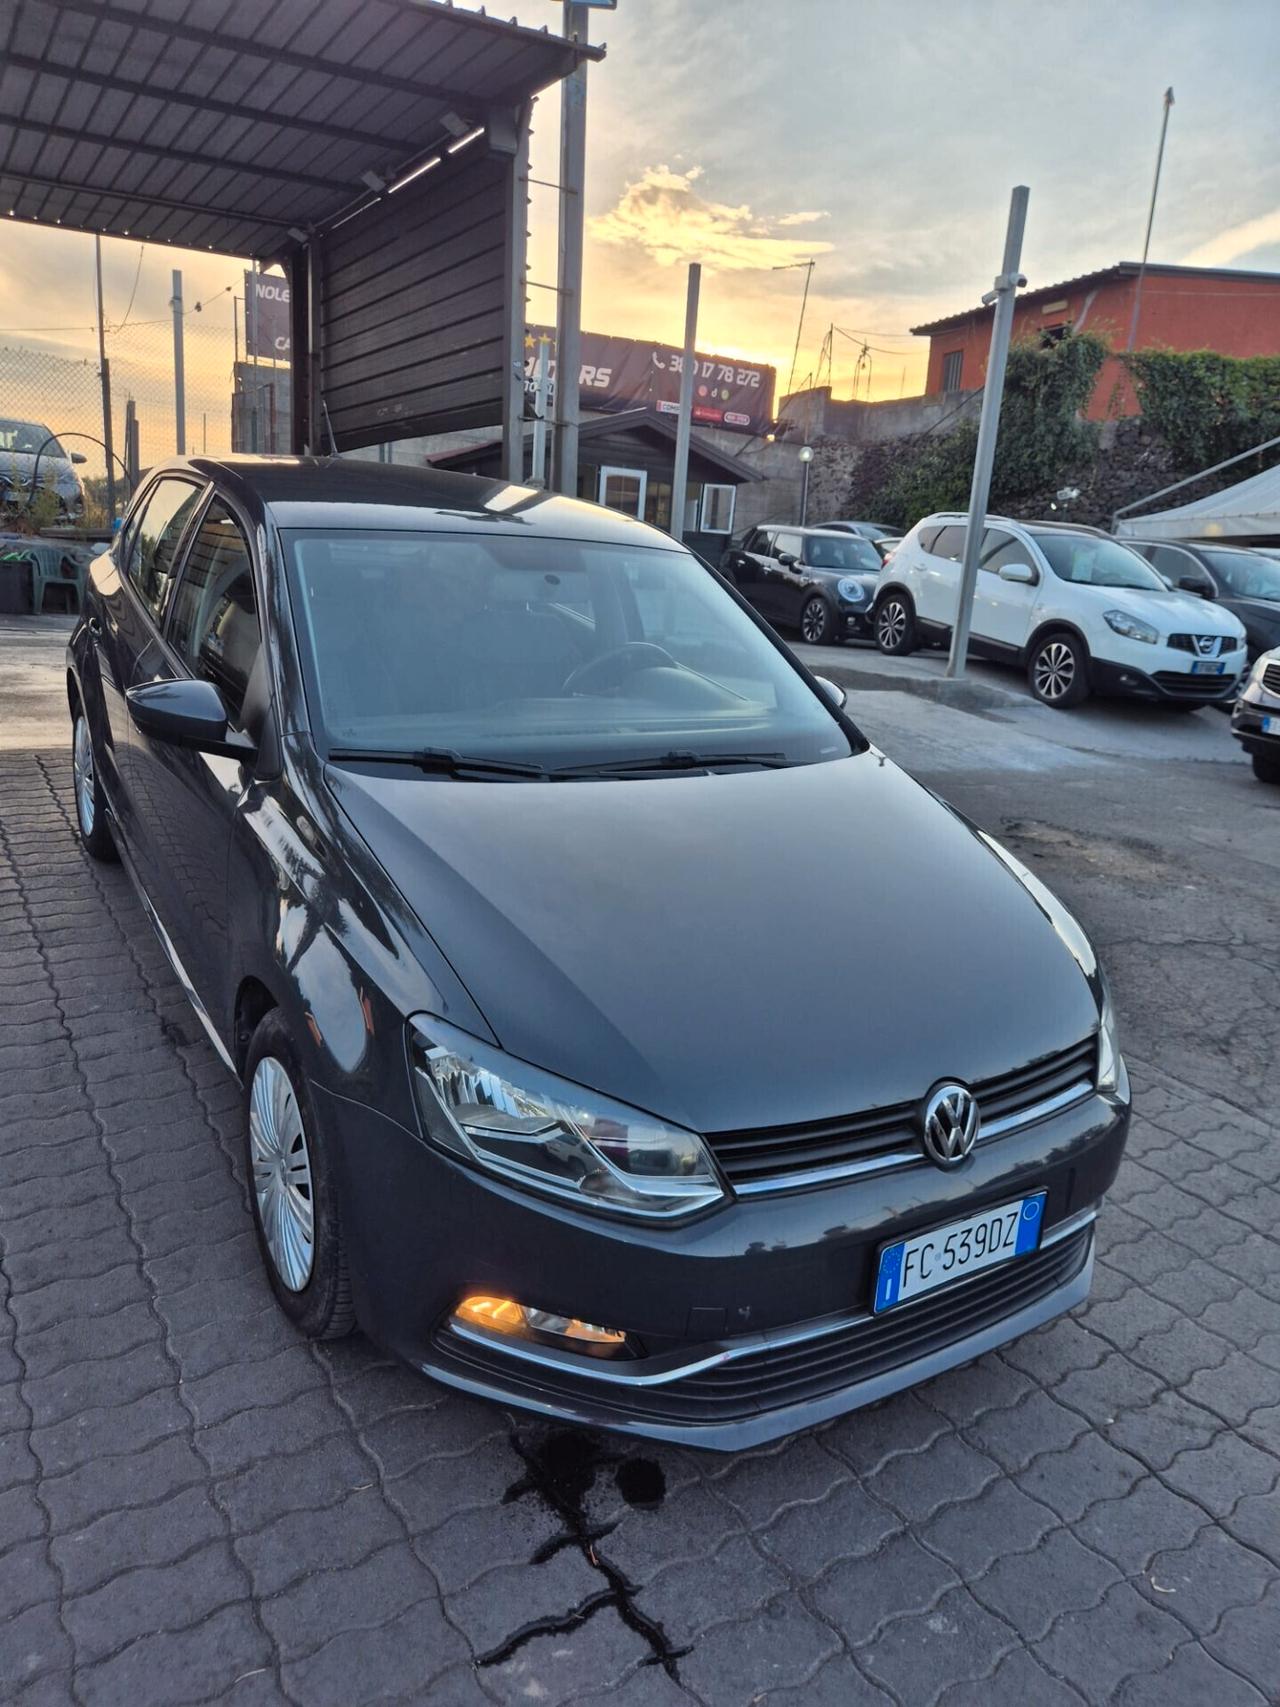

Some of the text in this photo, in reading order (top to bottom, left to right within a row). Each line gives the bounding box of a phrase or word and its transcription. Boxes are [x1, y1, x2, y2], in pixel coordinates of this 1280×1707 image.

[702, 362, 715, 378] 17
[717, 364, 734, 382] 78
[737, 368, 760, 388] 272
